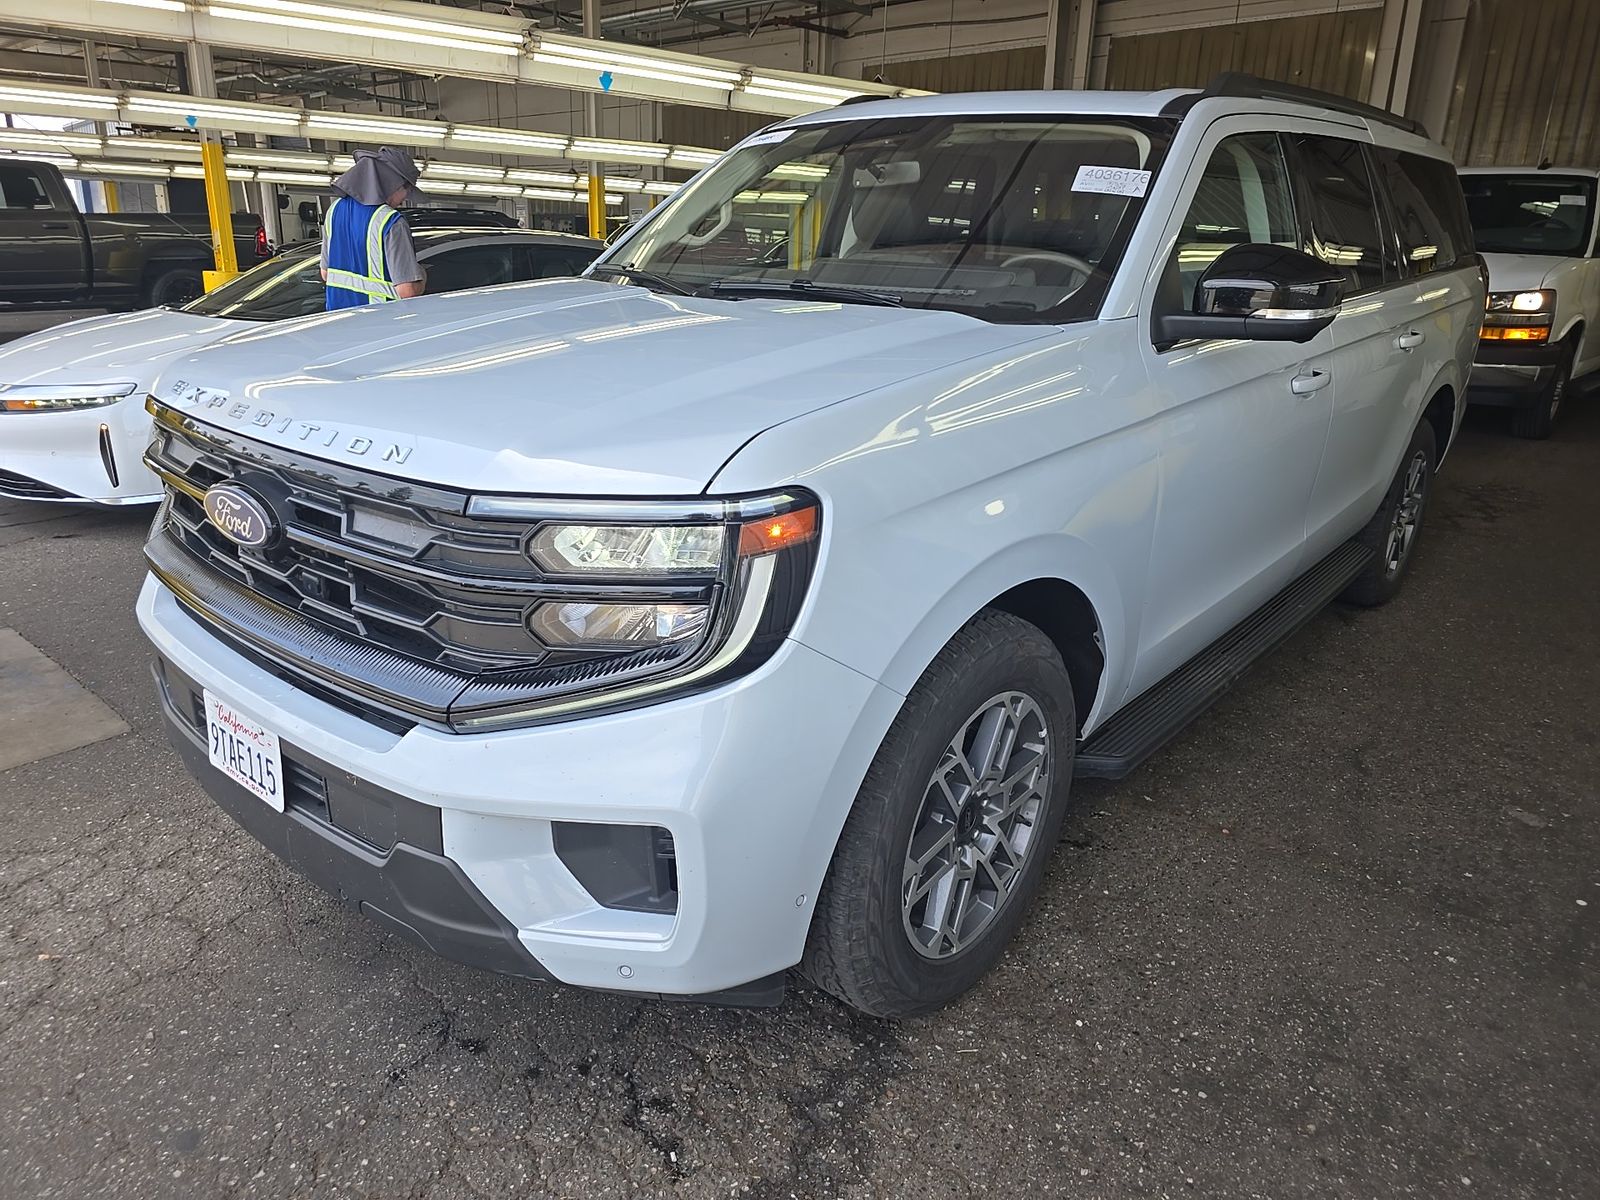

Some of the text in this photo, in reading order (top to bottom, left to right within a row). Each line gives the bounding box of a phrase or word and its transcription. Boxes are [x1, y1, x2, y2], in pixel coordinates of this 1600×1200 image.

[1085, 169, 1150, 184] 4036176
[171, 379, 413, 465] EXPEDITION
[214, 494, 253, 540] Ford
[217, 703, 265, 747] California
[211, 721, 277, 796] 9TAE115
